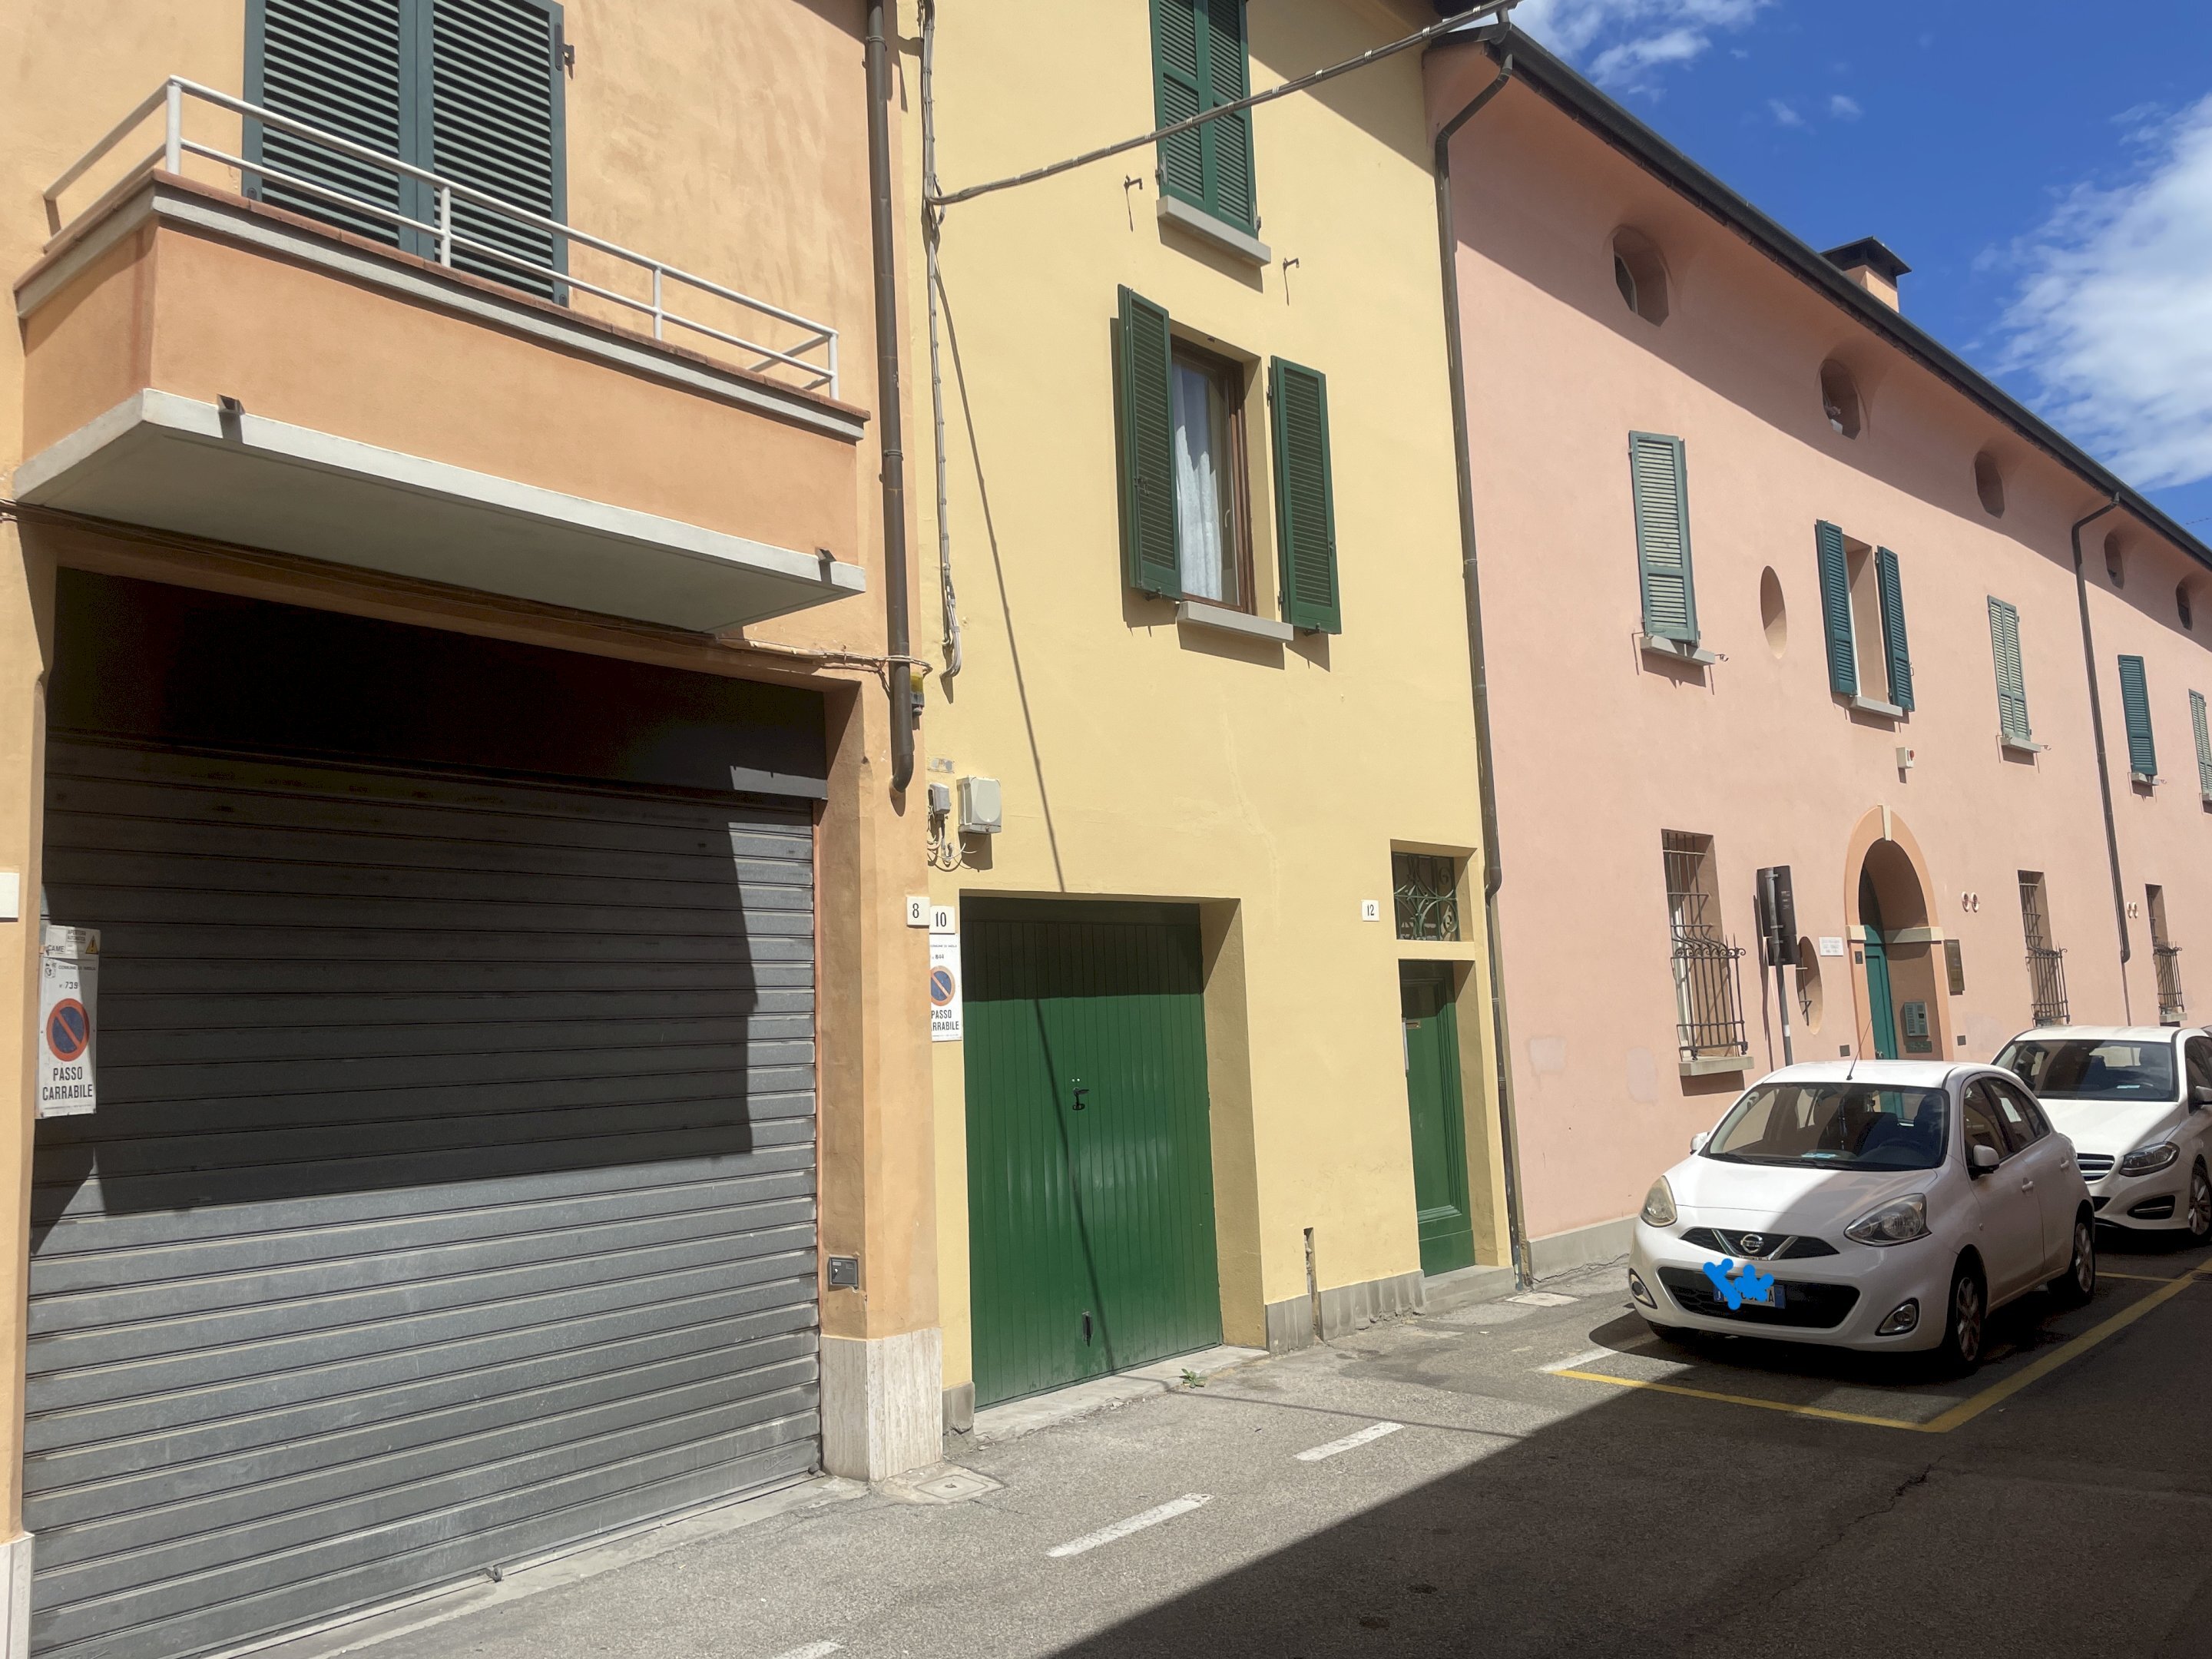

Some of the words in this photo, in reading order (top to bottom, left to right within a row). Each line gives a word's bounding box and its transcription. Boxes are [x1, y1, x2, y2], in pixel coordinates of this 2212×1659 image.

[912, 902, 919, 919] 8
[1367, 904, 1374, 916] 12
[935, 912, 946, 927] 10
[931, 1009, 952, 1019] PASSO
[932, 1021, 959, 1031] RRABILE
[53, 1066, 83, 1081] PASSO
[42, 1084, 93, 1101] CARRABILE
